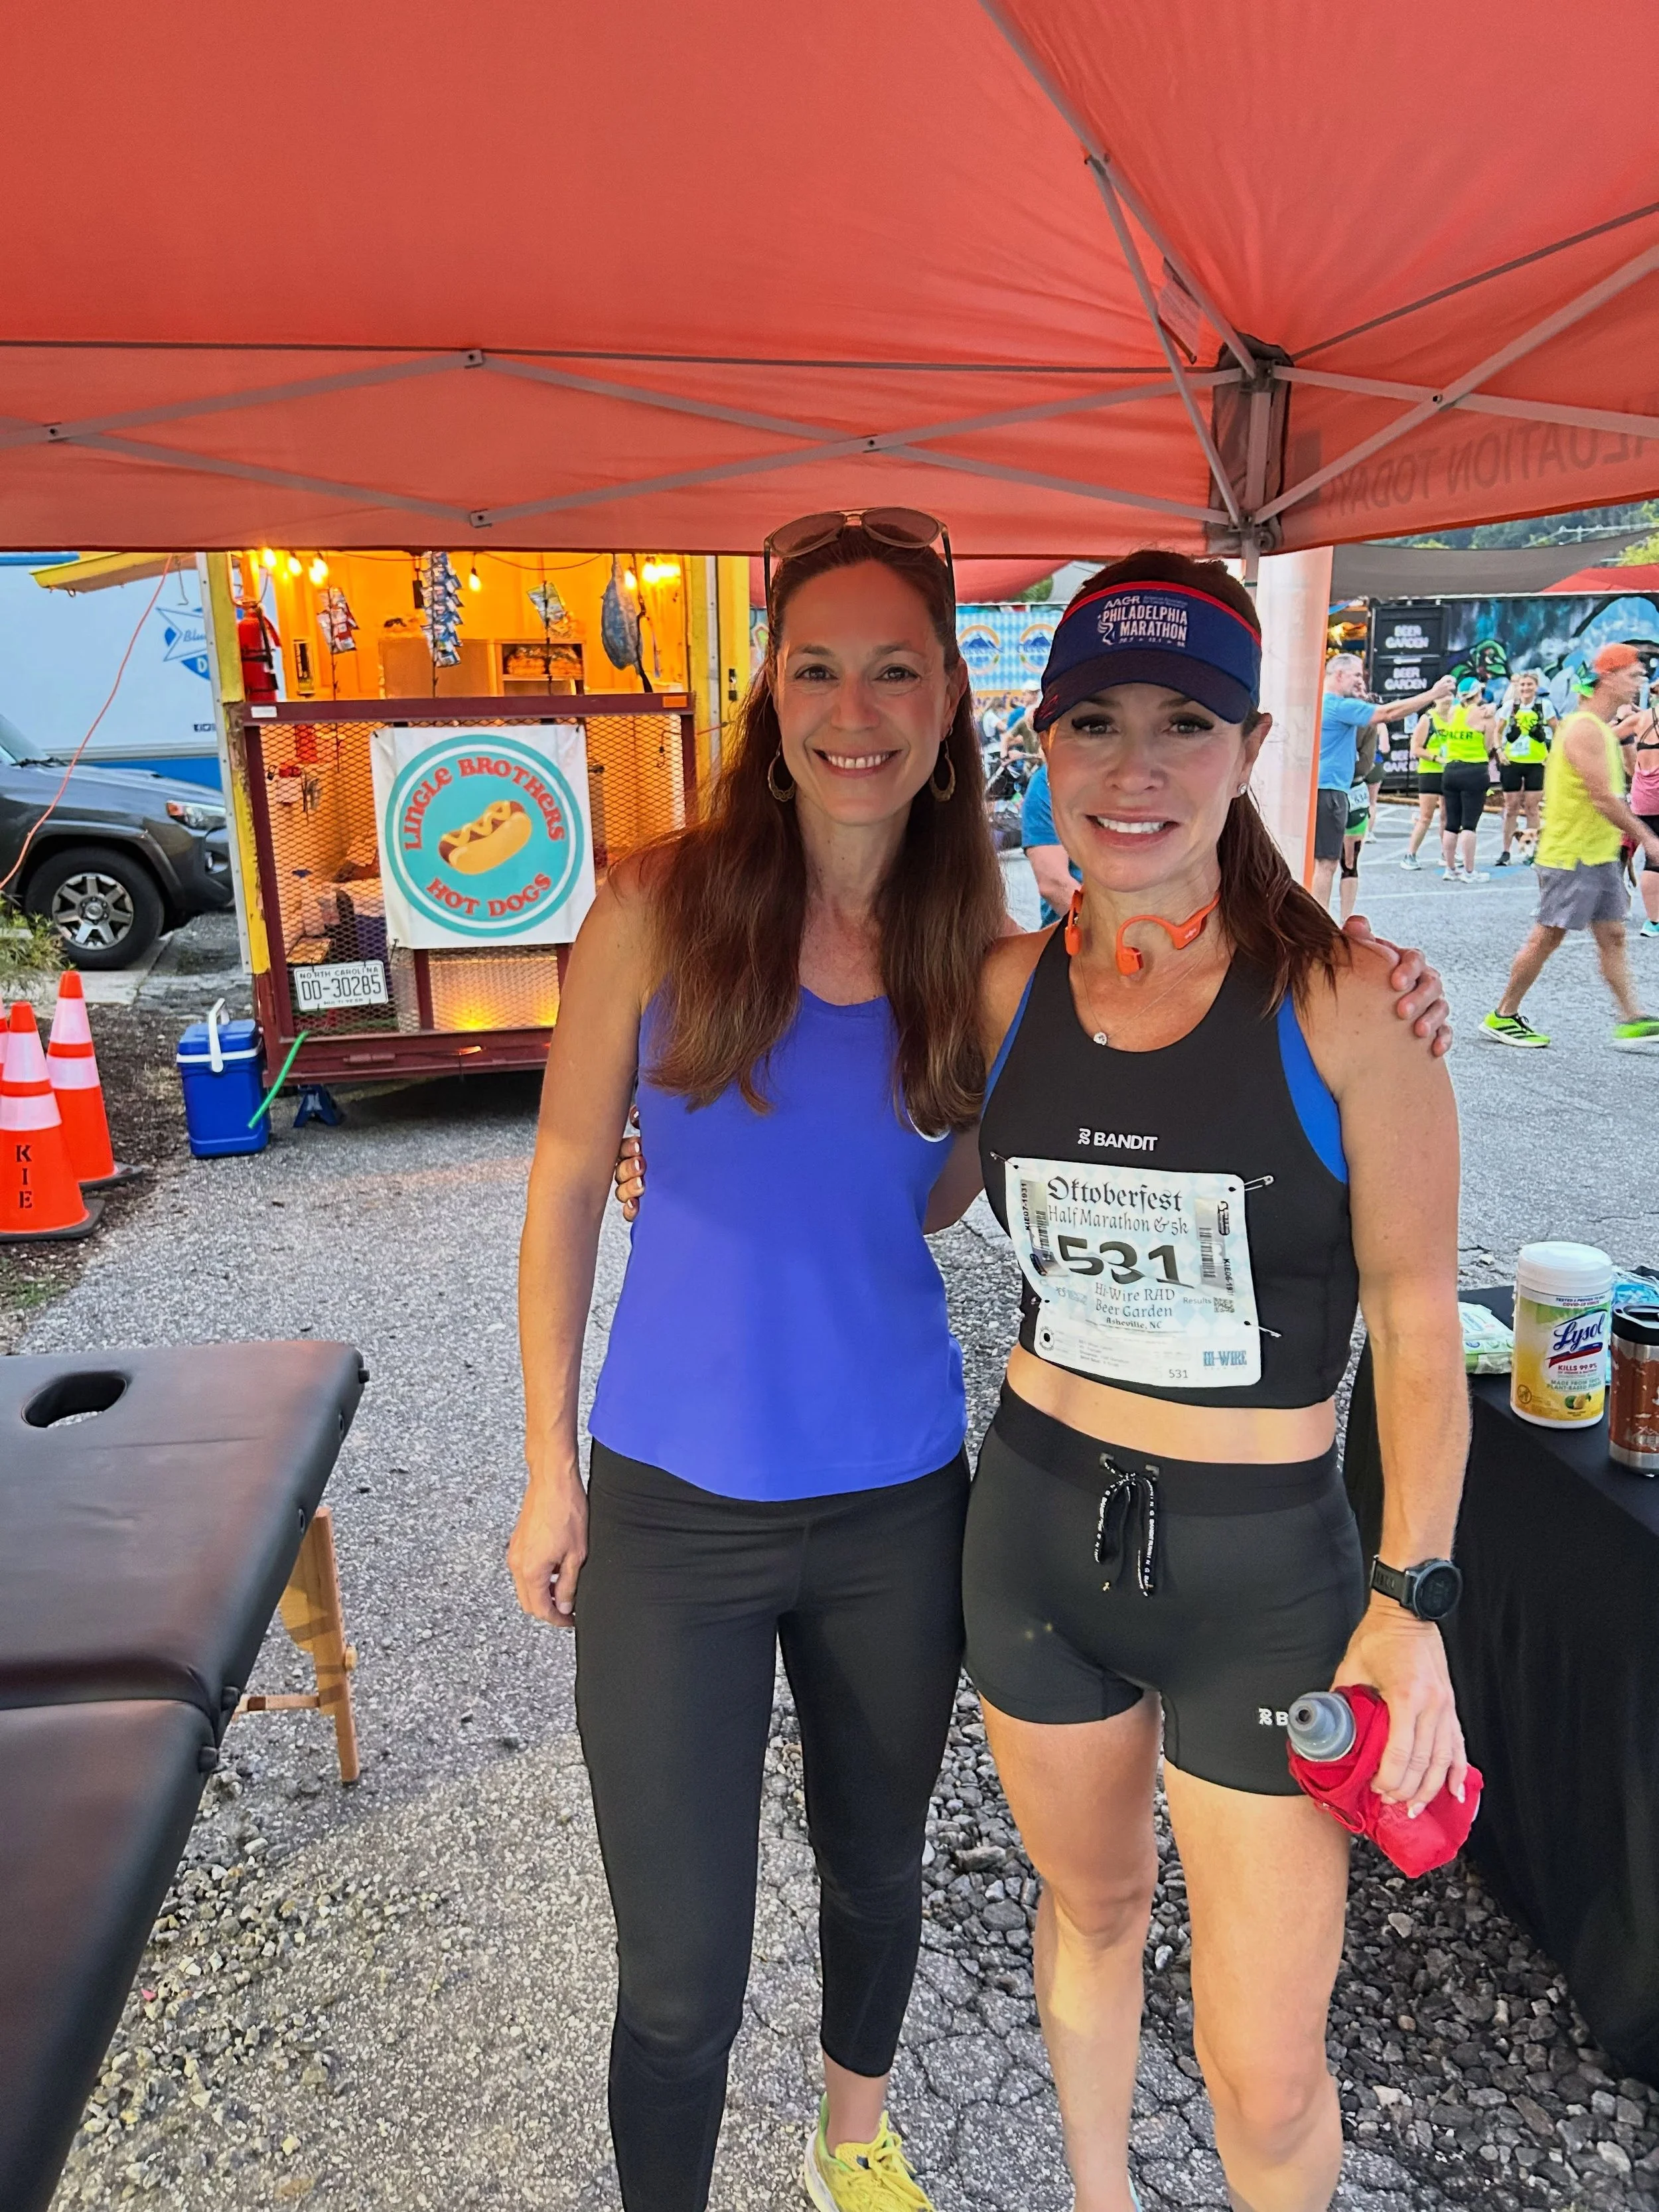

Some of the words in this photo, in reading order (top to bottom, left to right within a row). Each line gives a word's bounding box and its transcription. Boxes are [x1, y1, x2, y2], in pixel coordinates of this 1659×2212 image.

[1102, 605, 1188, 626] PHILADELPHIA
[1119, 621, 1187, 641] MARATHON
[1394, 625, 1422, 637] BEER
[1385, 636, 1429, 648] GARDEN
[1393, 666, 1420, 678] BEER
[1384, 678, 1427, 691] GARDEN
[426, 877, 480, 915] HOT
[487, 873, 552, 917] DOGS
[299, 970, 330, 979] NORTH
[334, 966, 378, 976] CAROLINA
[301, 974, 382, 1001] DD-30285
[1093, 1132, 1158, 1151] BANDIT
[15, 1144, 33, 1209] KIE
[1047, 1175, 1183, 1214] Oktoberfest
[1021, 1183, 1031, 1230] KIE07-1931
[1048, 1205, 1078, 1228] Half
[1080, 1208, 1150, 1232] Marathon
[1154, 1216, 1170, 1233] &
[1057, 1234, 1194, 1289] 531
[1095, 1282, 1140, 1302] Hi-Wire
[1145, 1288, 1175, 1301] RAD
[1095, 1298, 1119, 1315] Beer
[1123, 1306, 1173, 1317] Garden
[1553, 1313, 1605, 1352] Lysol
[1169, 1369, 1189, 1379] 531
